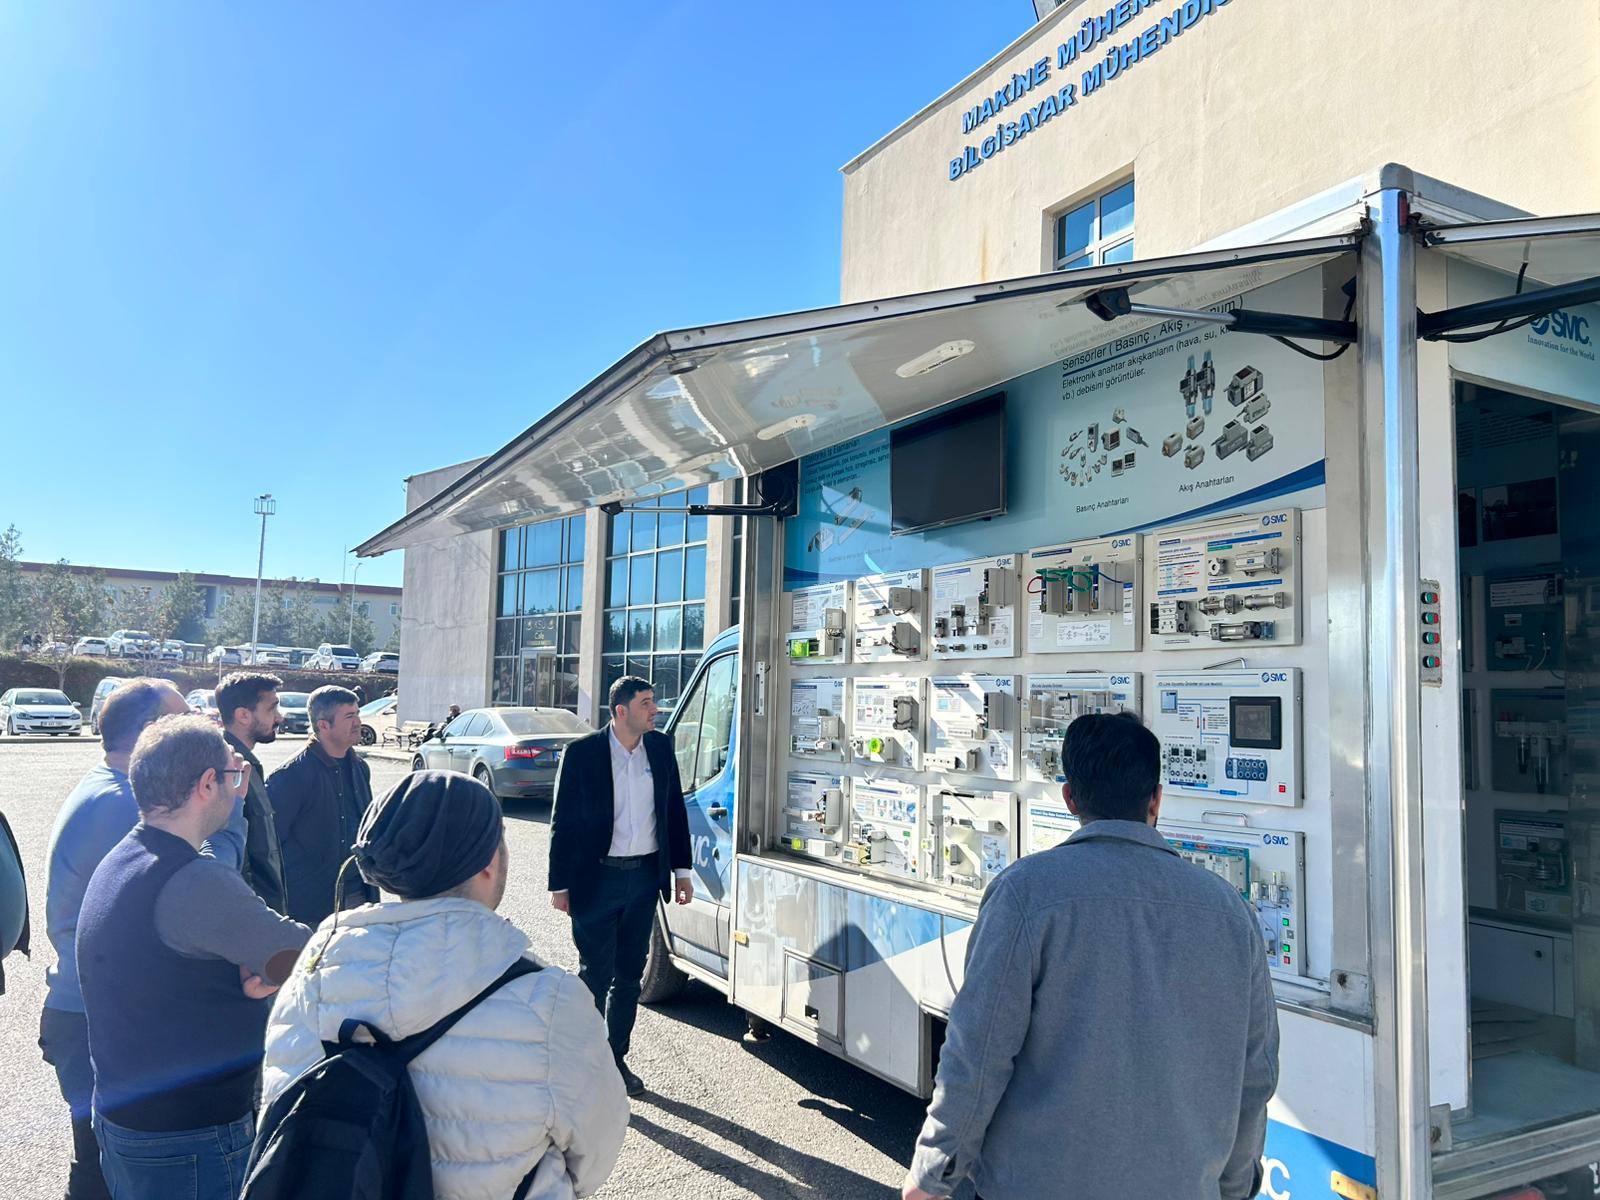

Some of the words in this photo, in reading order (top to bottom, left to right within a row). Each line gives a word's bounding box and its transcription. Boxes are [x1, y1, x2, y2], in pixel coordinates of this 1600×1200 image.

[962, 56, 1050, 134] MAKİNE
[949, 84, 1075, 181] BİLGİSAYAR
[1115, 332, 1150, 352] Basınç
[1160, 319, 1183, 336] Akış
[1551, 309, 1590, 345] SMC
[1527, 334, 1559, 351] Innovation
[1560, 343, 1569, 353] for
[1570, 347, 1578, 357] the
[1579, 350, 1595, 361] World
[1062, 370, 1096, 389] Elektronik
[1098, 361, 1126, 377] anahtar
[1128, 344, 1174, 366] akışkanların
[1076, 380, 1104, 397] debisini
[1179, 482, 1194, 493] Akış
[1195, 475, 1235, 489] Anahtarları
[1076, 503, 1096, 513] Basınç
[1270, 513, 1287, 524] SMC
[1118, 538, 1131, 547] SMC
[1118, 677, 1130, 685] SMC
[1270, 672, 1287, 682] SMC
[1272, 835, 1289, 846] SMC
[690, 833, 710, 868] MC
